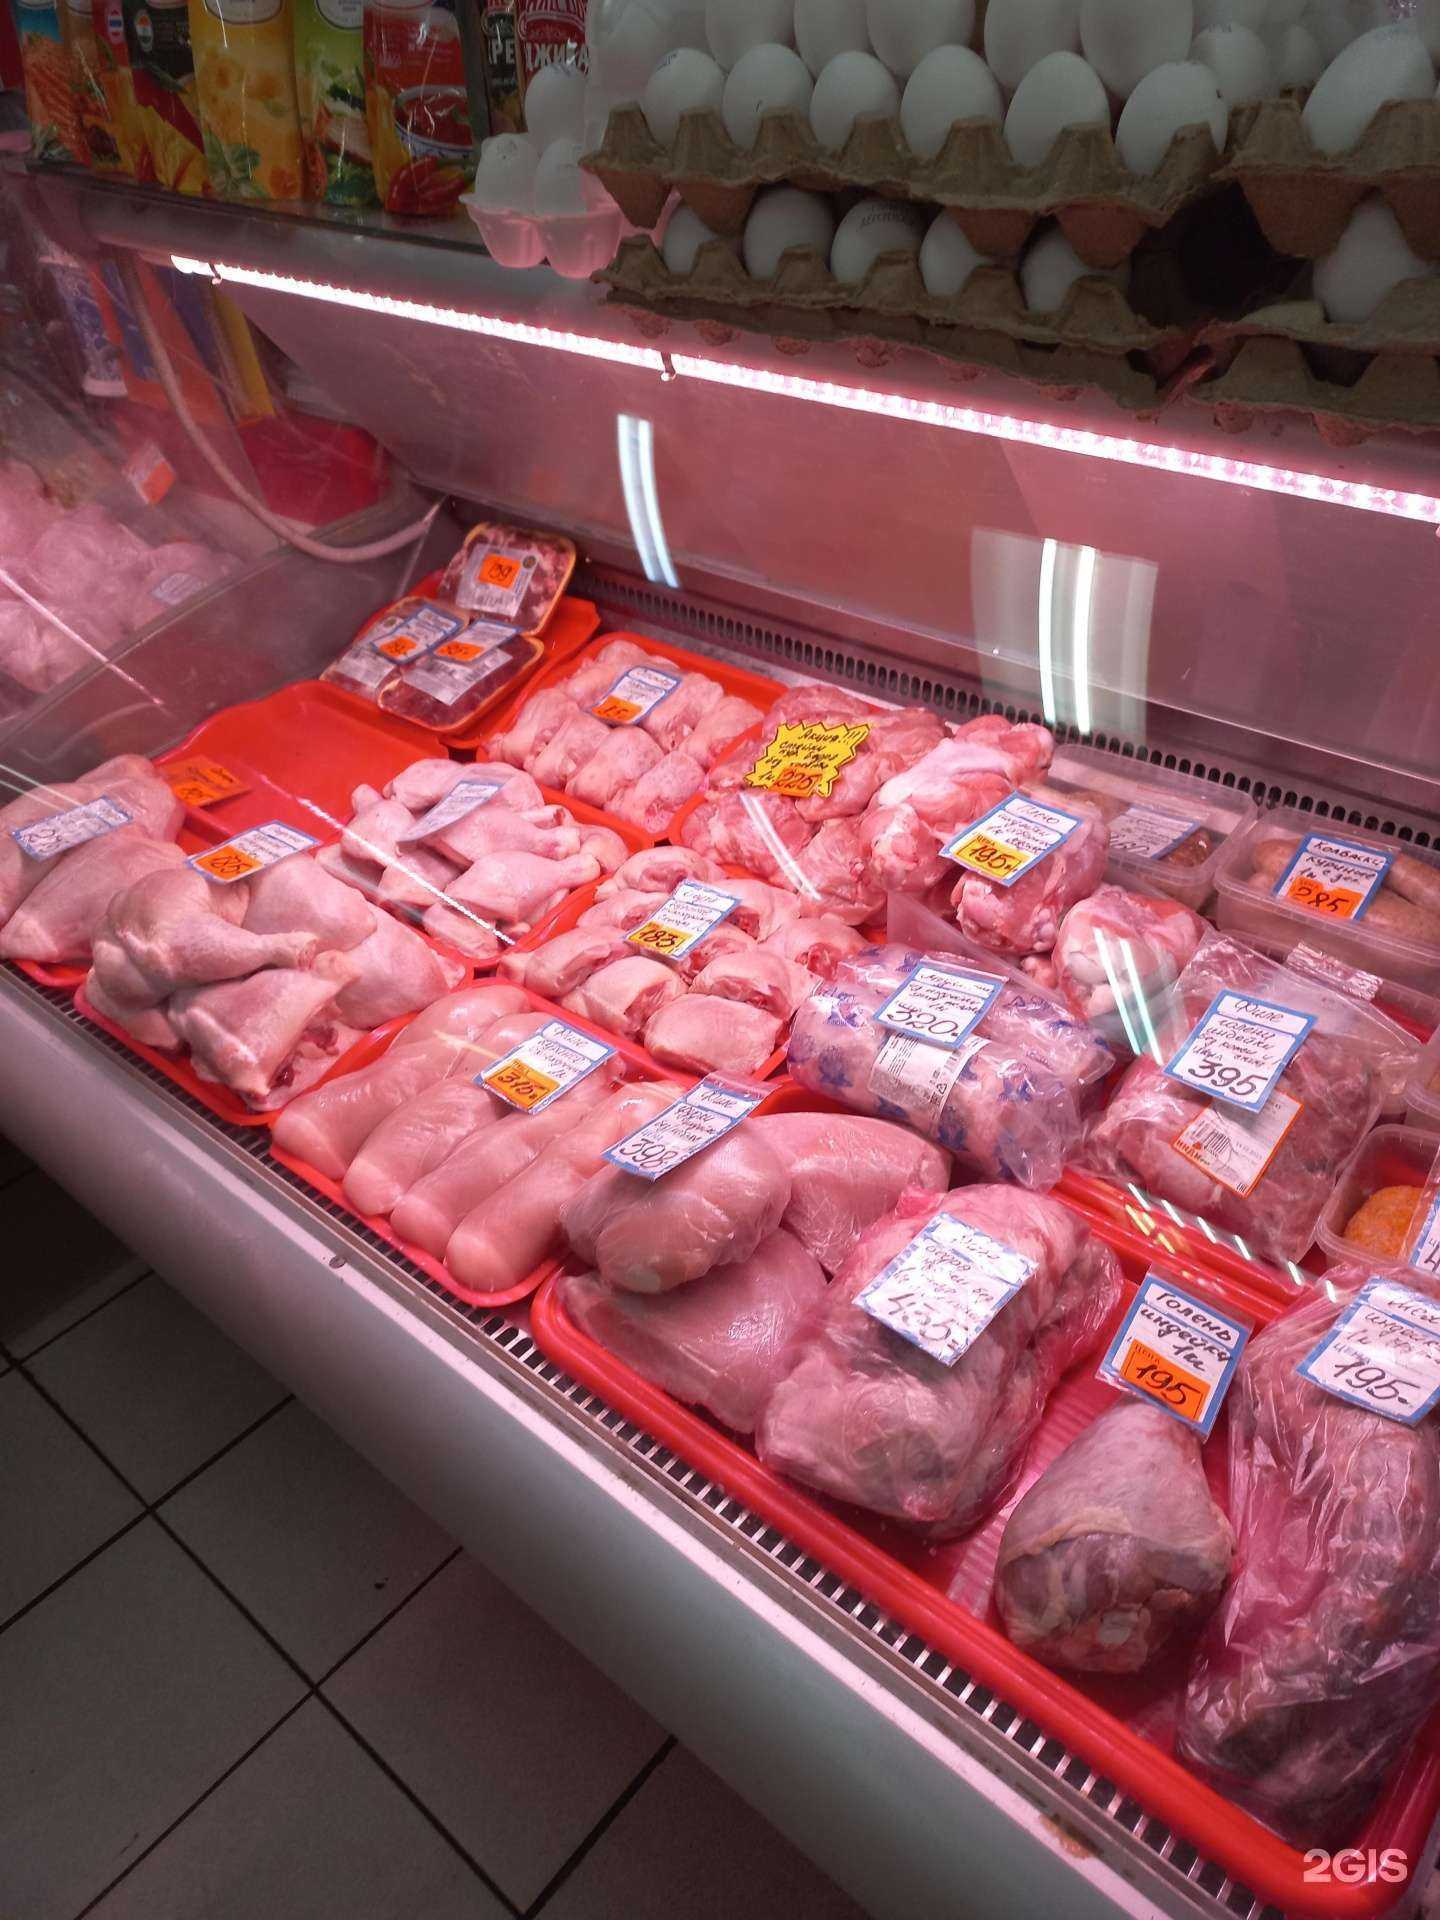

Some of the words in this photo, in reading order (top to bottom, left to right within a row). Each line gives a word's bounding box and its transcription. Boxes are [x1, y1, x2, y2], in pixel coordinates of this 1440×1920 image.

[1234, 999, 1284, 1023] Филе
[1187, 1058, 1269, 1096] 395
[1140, 1308, 1233, 1362] индейки
[1156, 1292, 1232, 1341] Голень
[1136, 1363, 1201, 1406] 195
